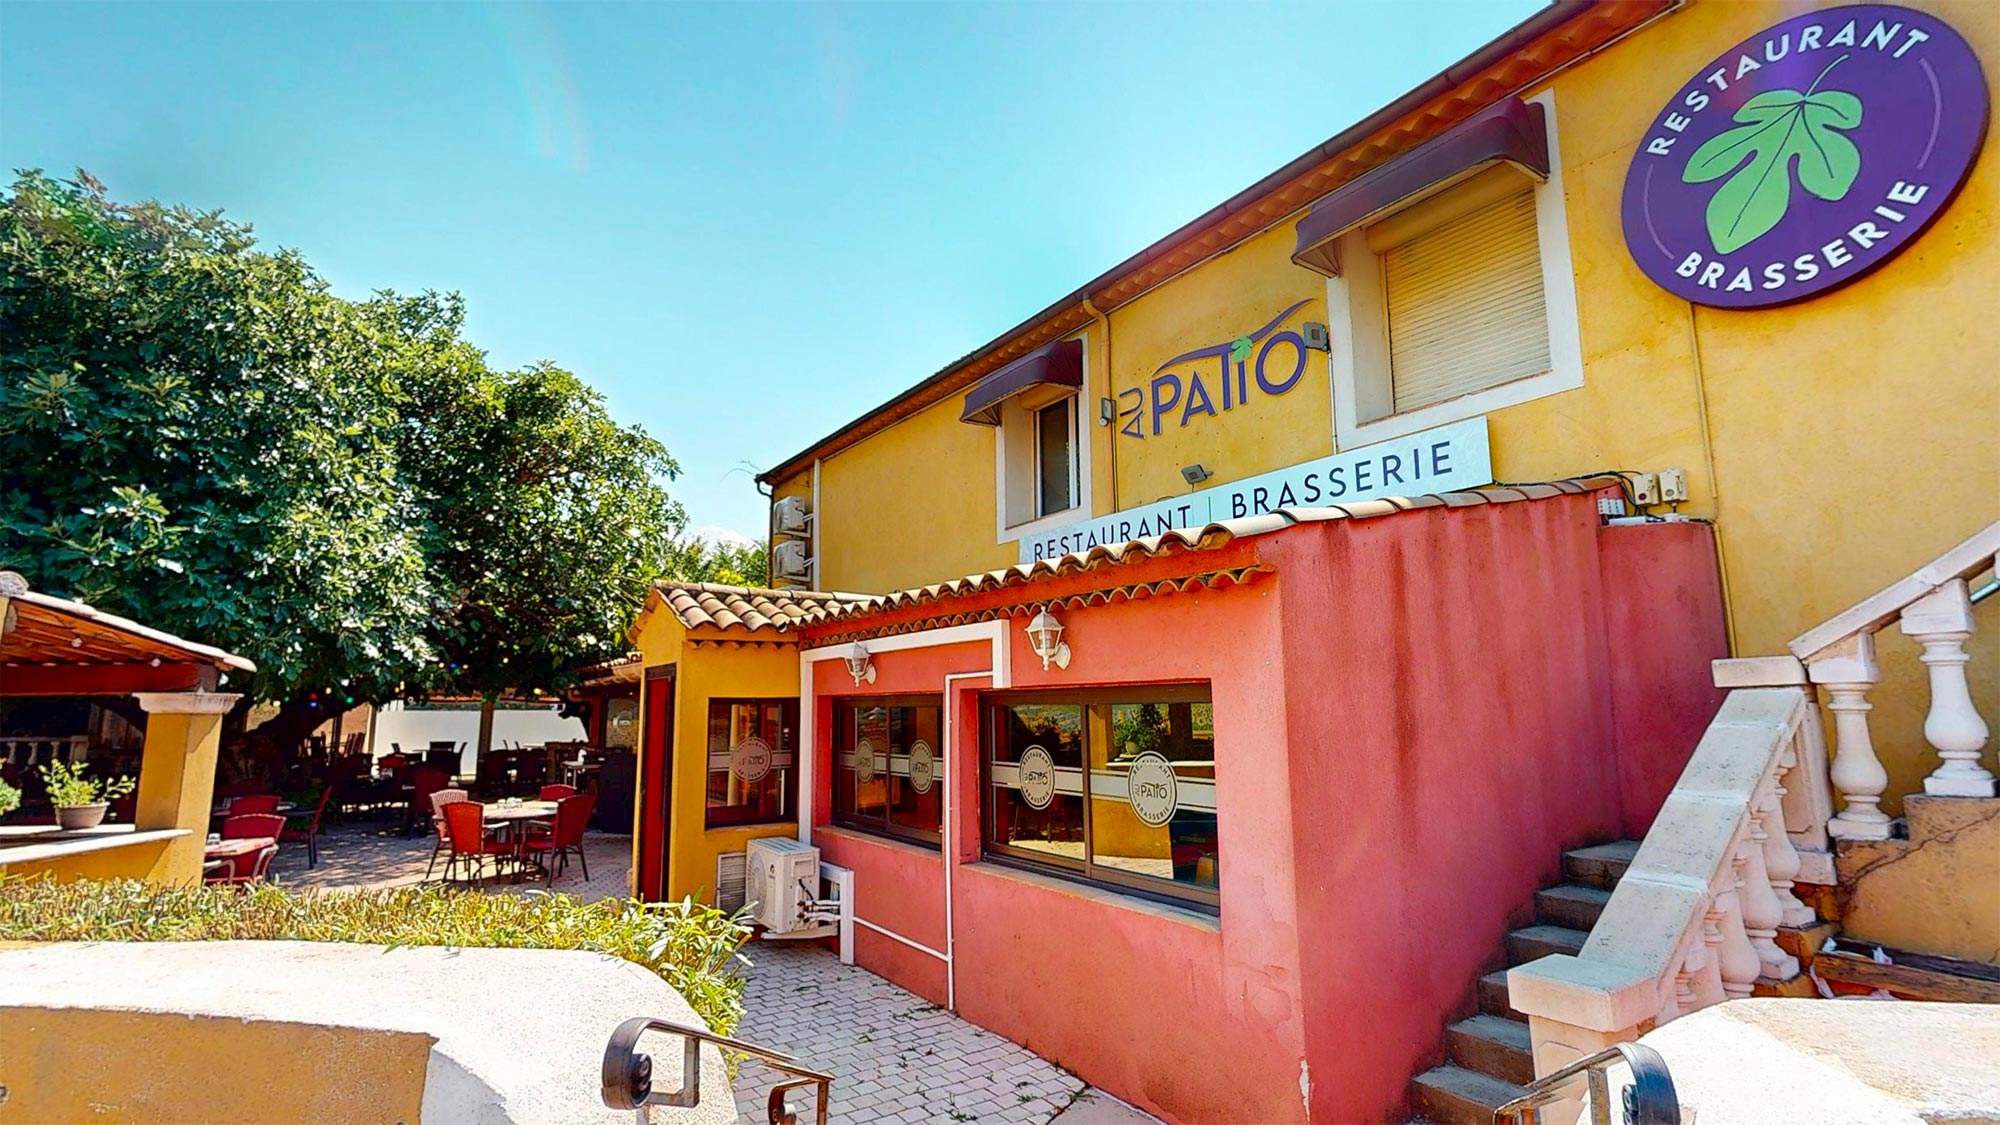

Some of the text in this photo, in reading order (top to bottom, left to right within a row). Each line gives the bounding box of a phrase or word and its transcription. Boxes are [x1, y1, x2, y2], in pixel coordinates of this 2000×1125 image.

[1647, 20, 1930, 156] RESTAURANT
[1675, 180, 1930, 292] BRASSERIE
[1118, 329, 1309, 440] AU PATIO
[1033, 441, 1453, 564] RESTAURANT BRASSERIE
[1140, 782, 1169, 799] PATIO
